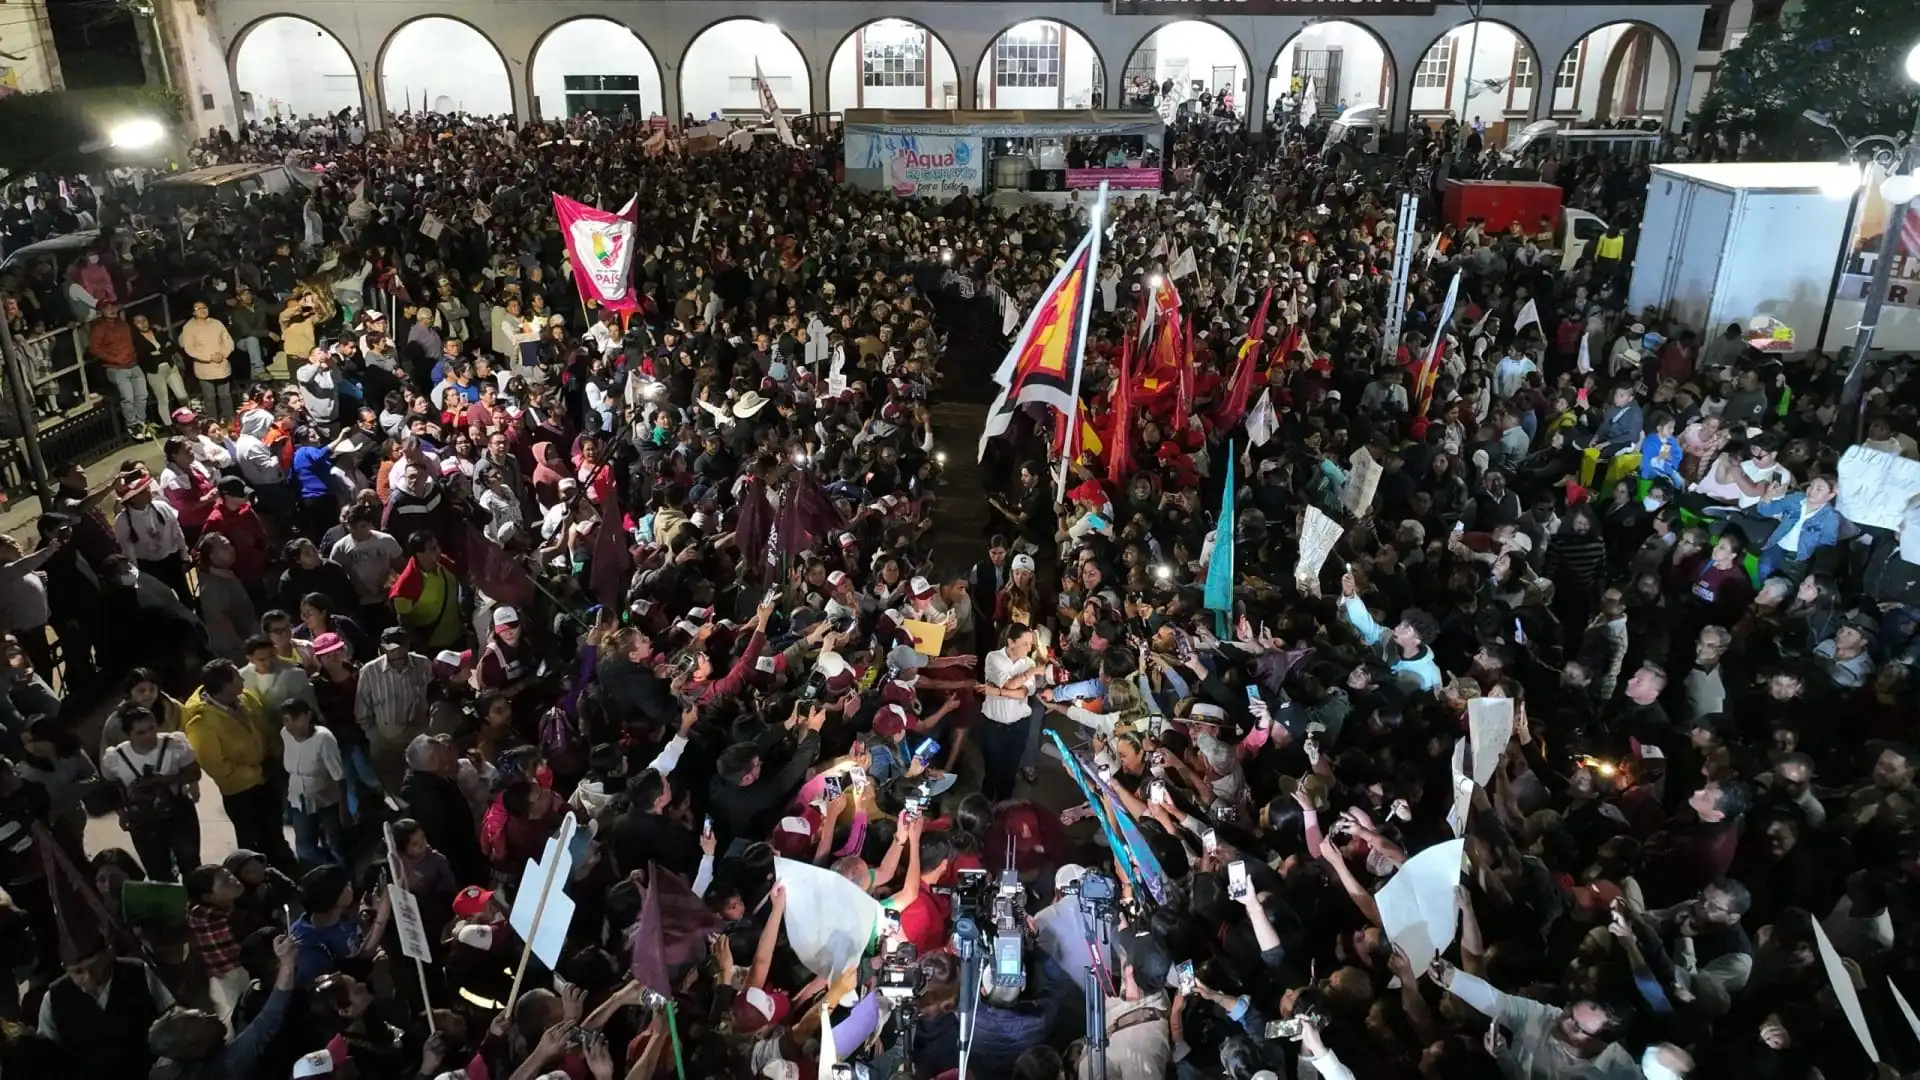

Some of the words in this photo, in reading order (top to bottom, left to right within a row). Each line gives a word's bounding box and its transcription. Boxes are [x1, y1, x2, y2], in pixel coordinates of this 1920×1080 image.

[906, 150, 954, 169] Agua
[916, 181, 938, 192] para
[596, 272, 621, 284] PAÍS
